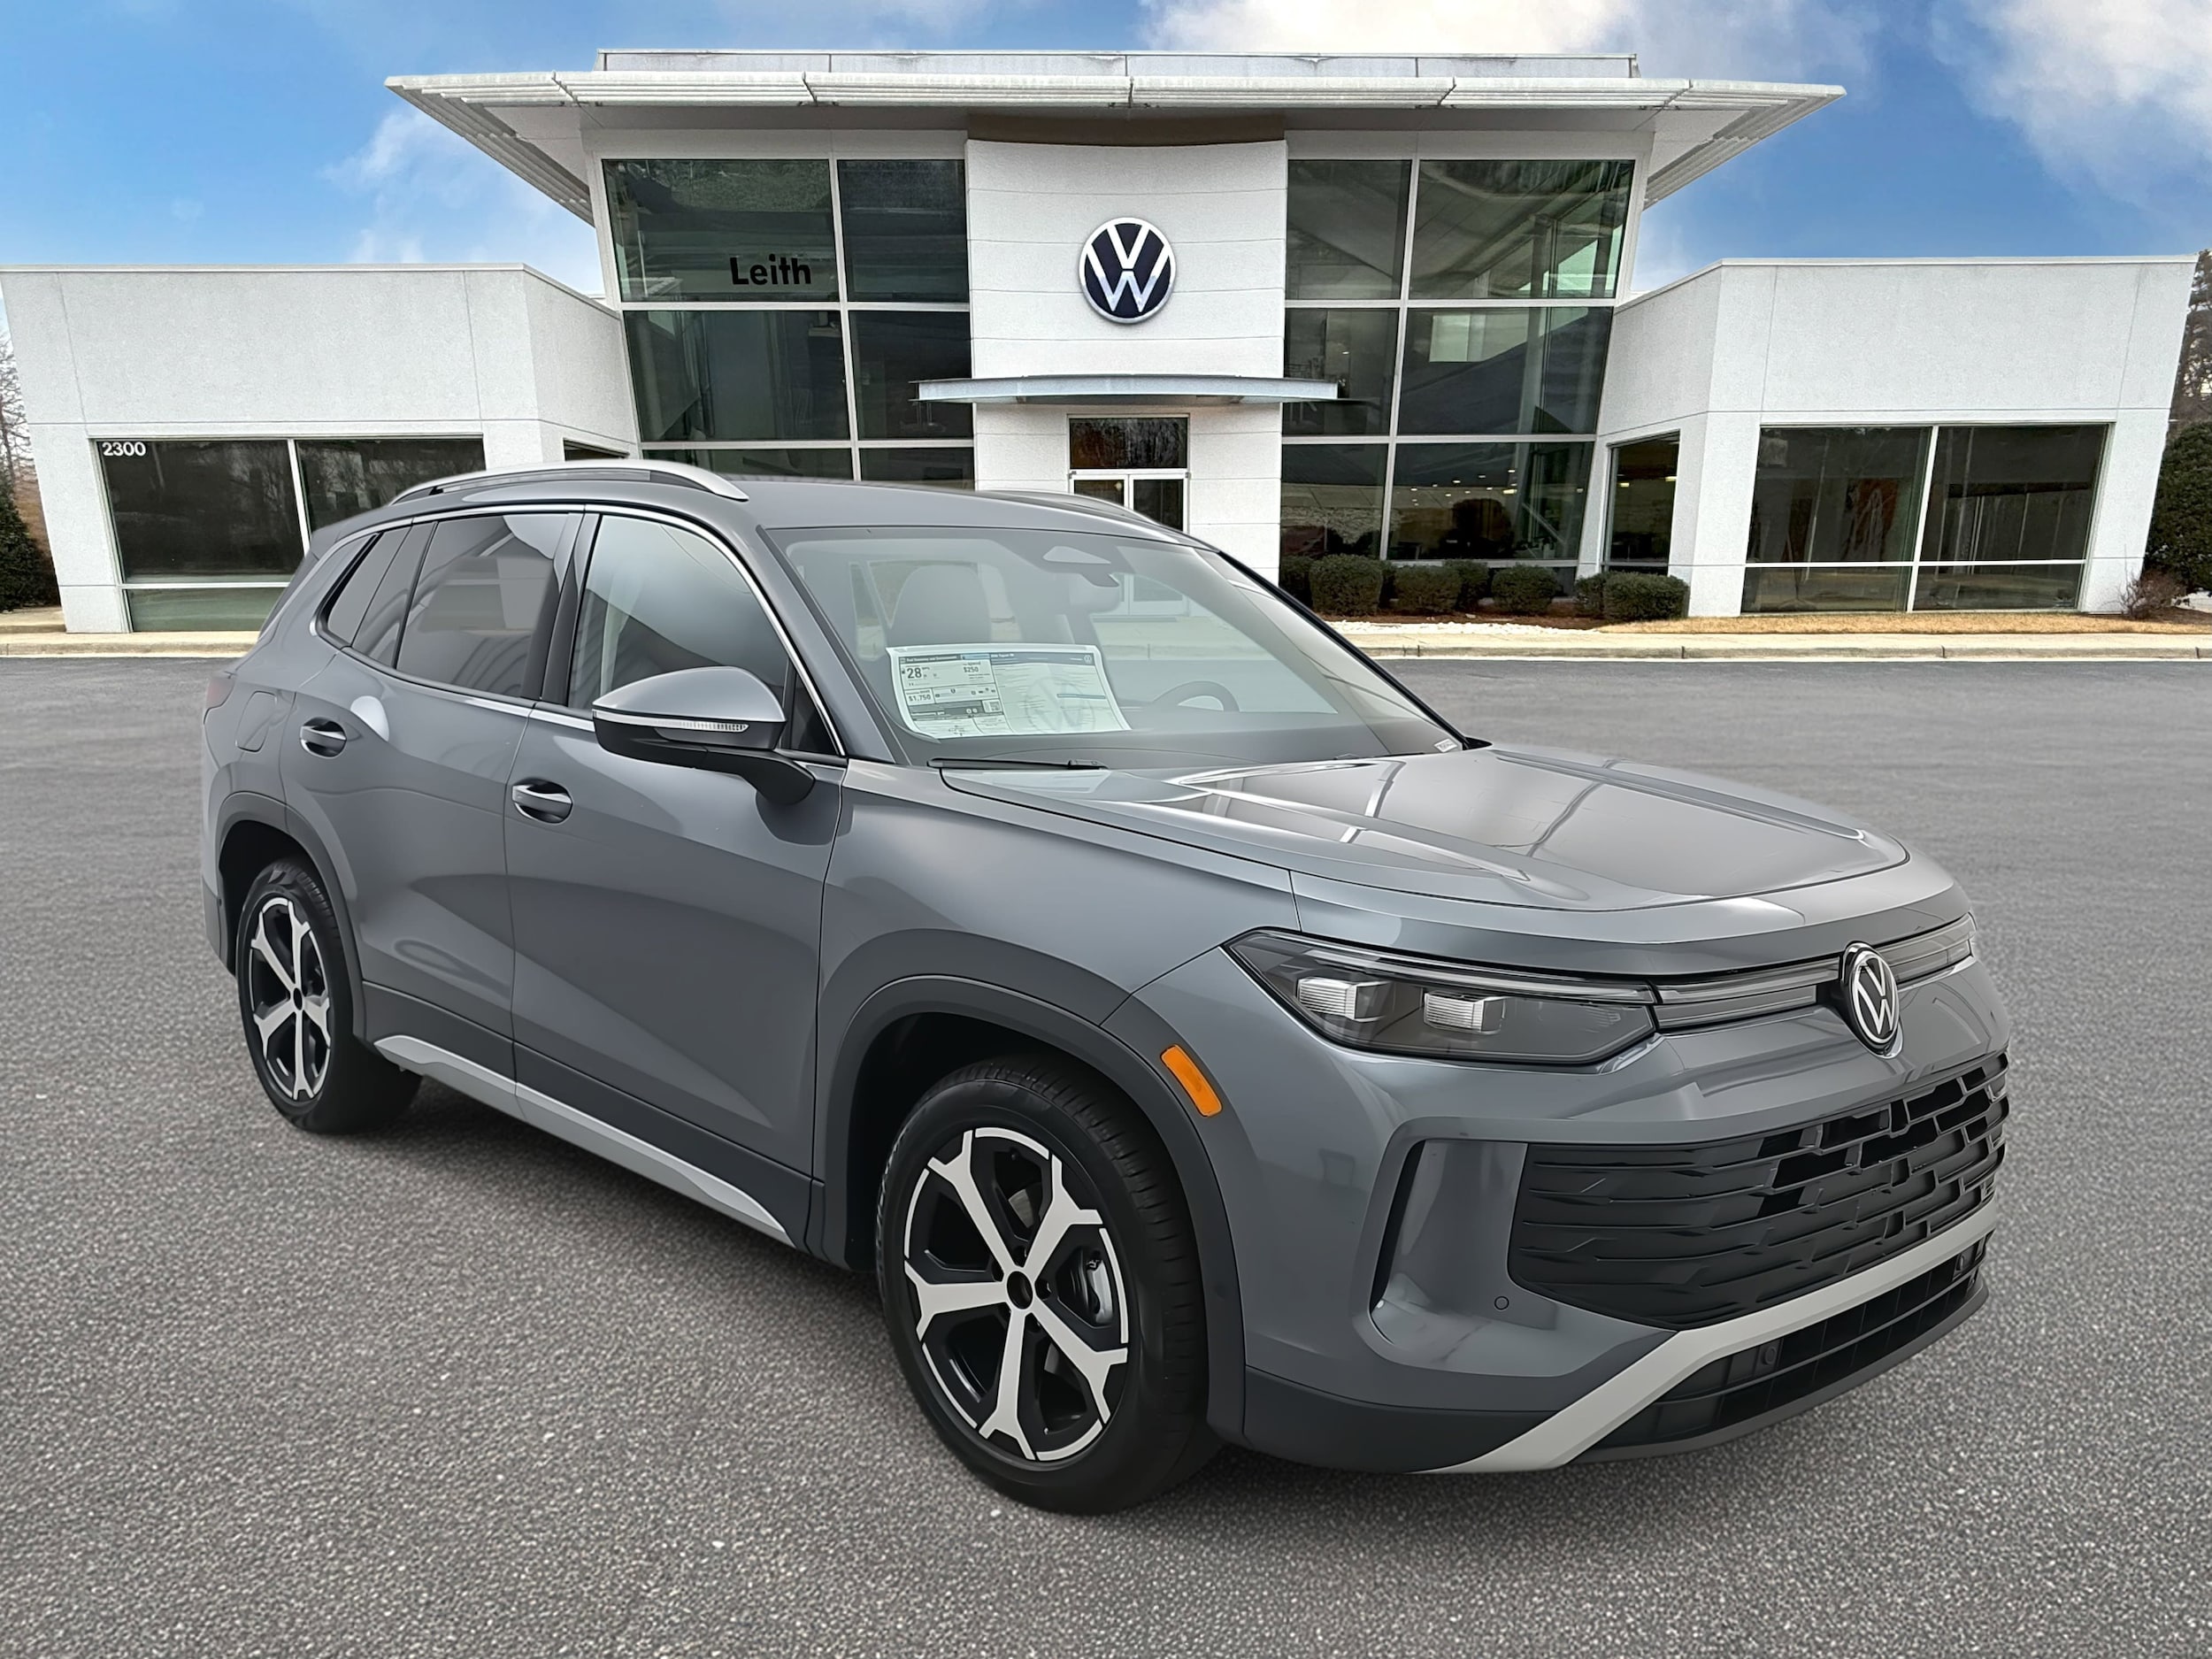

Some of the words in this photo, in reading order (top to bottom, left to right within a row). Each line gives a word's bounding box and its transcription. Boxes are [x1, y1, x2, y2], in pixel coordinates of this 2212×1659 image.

[730, 254, 812, 286] Leith
[1084, 221, 1172, 315] VW
[102, 442, 147, 457] 2300
[907, 667, 922, 679] 28
[1854, 952, 1897, 1040] VW
